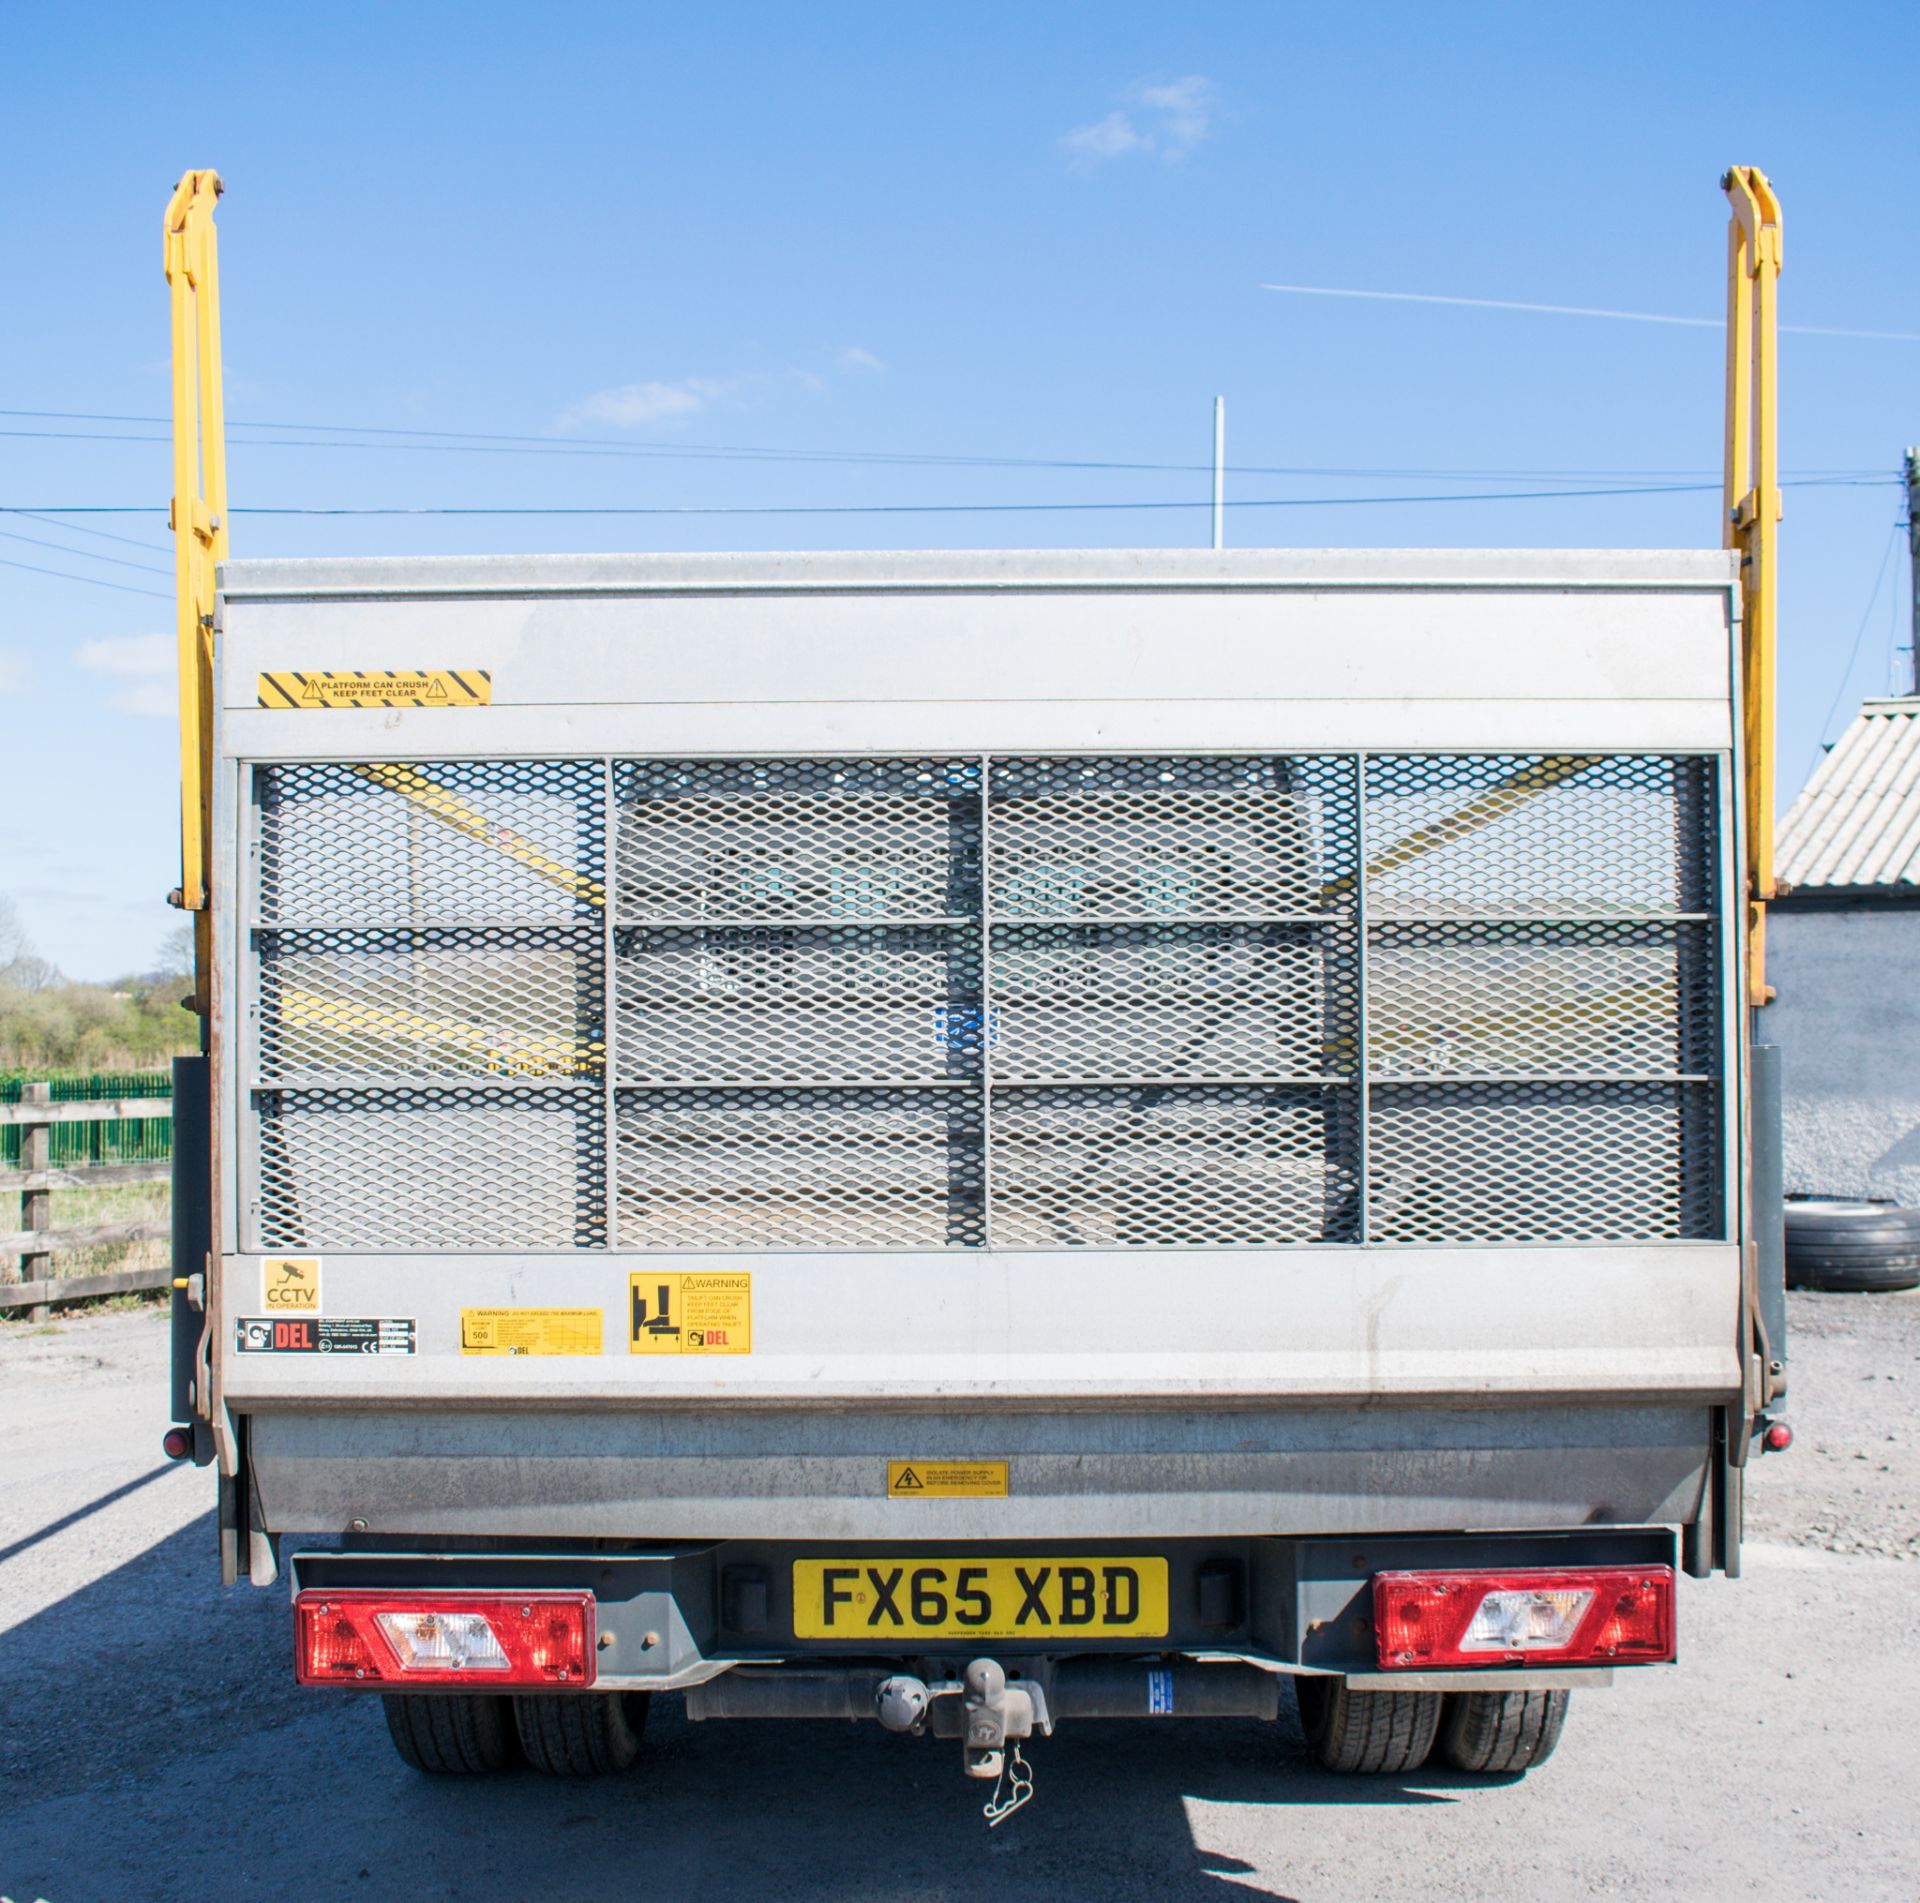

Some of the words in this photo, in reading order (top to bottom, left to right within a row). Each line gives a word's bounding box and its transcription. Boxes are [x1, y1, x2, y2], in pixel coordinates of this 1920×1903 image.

[321, 681, 371, 689] PLATFORM
[396, 680, 429, 688] CRUSH
[695, 1279, 748, 1288] WARNING
[267, 1288, 316, 1302] CCTV
[275, 1323, 313, 1348] DEL
[706, 1330, 729, 1345] DEL
[823, 1568, 992, 1626] FX65
[1014, 1566, 1140, 1626] XBD
